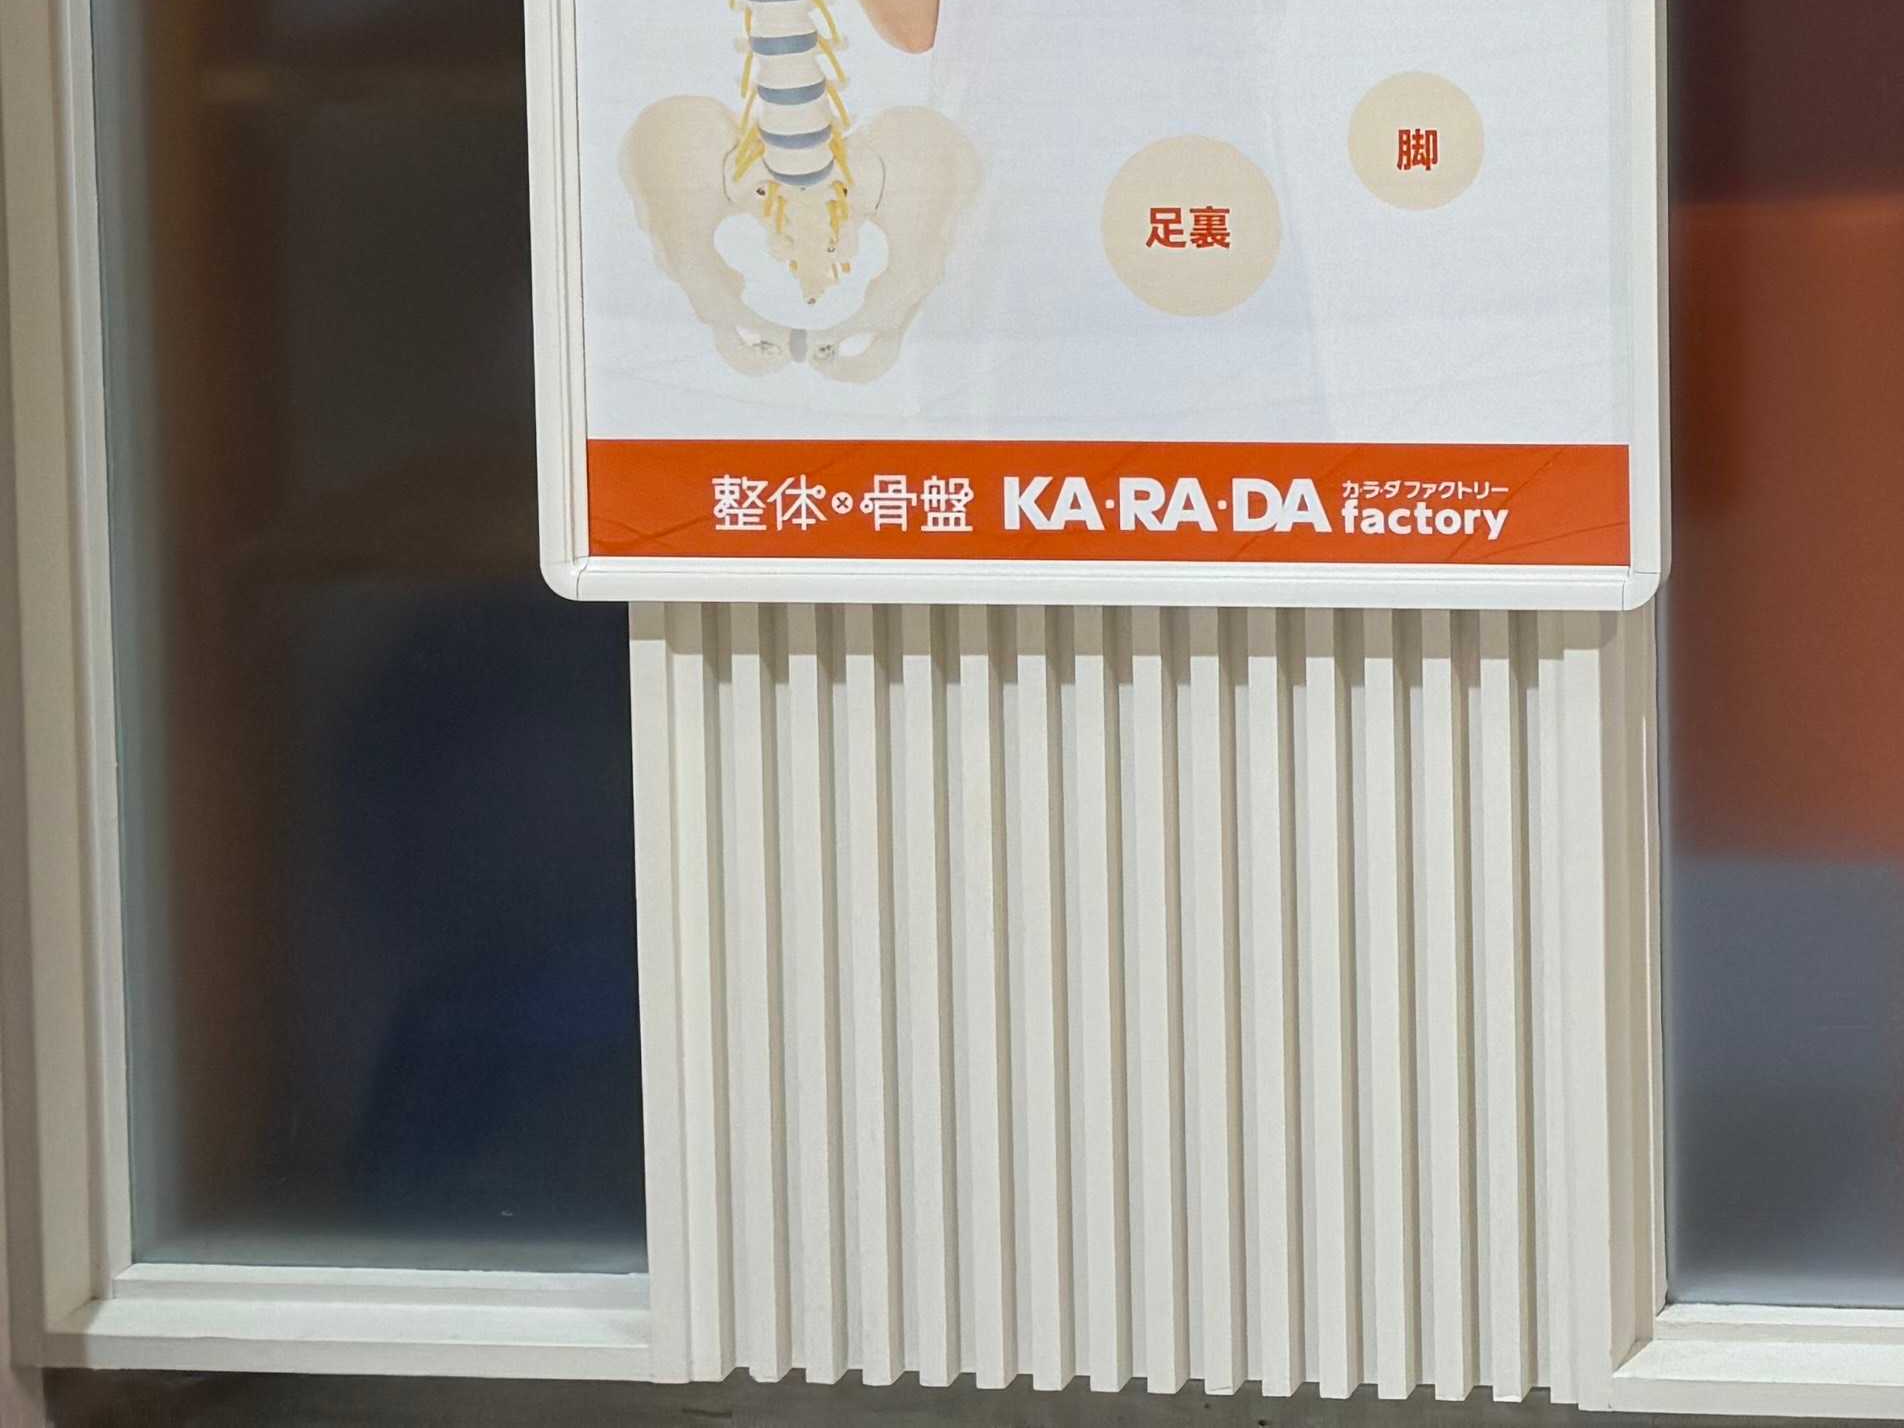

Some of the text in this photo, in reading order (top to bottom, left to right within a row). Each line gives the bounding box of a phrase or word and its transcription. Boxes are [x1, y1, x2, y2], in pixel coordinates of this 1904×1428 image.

[1397, 129, 1437, 170] 脚
[1146, 206, 1230, 248] 足裏
[1341, 499, 1509, 541] factory
